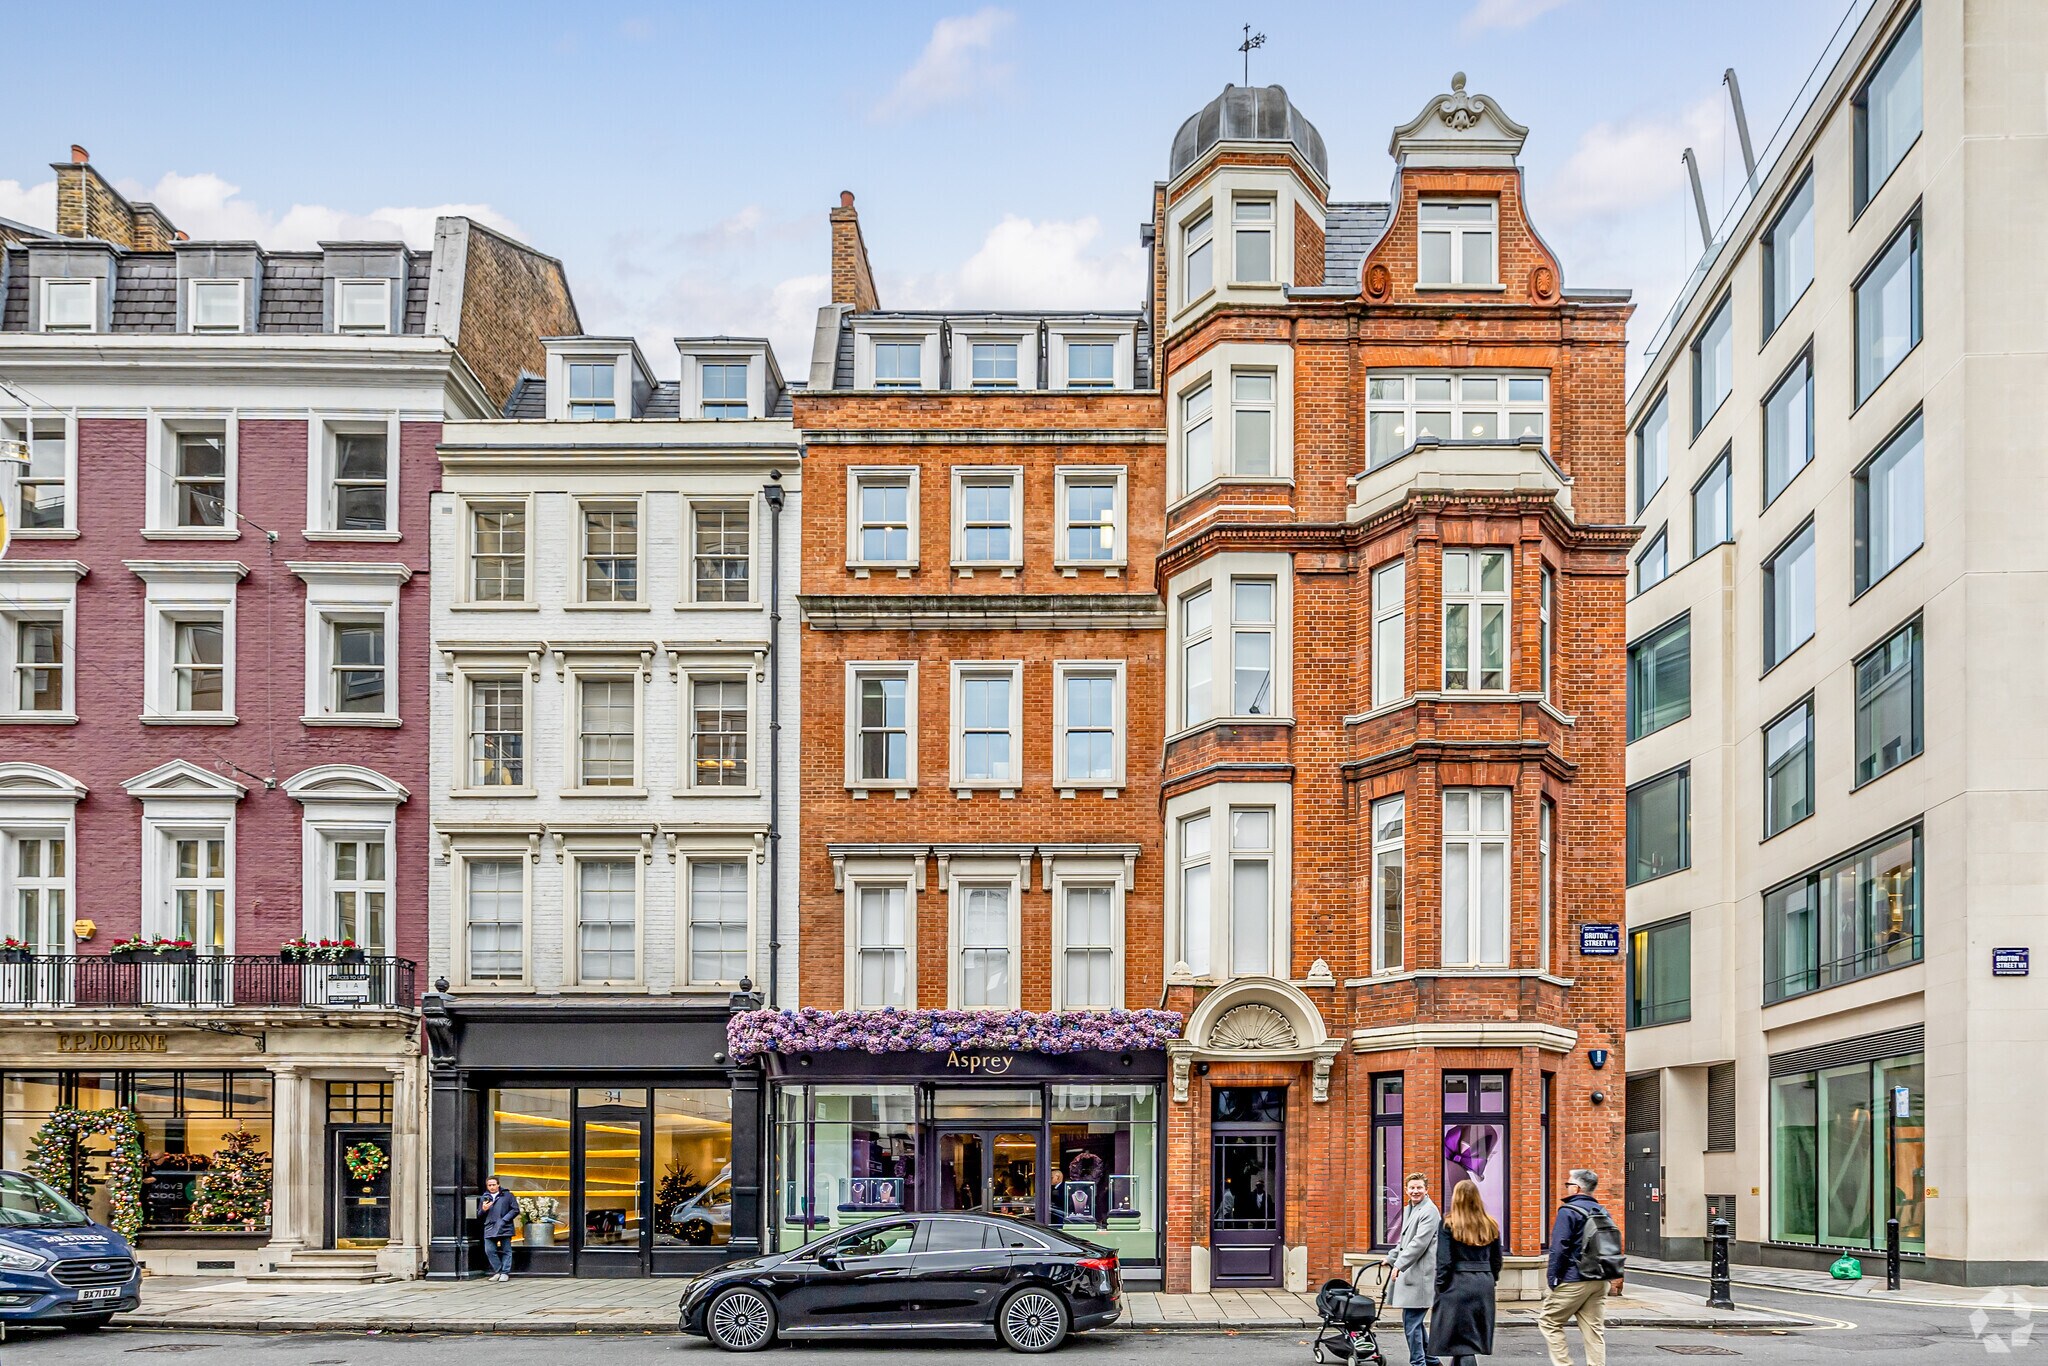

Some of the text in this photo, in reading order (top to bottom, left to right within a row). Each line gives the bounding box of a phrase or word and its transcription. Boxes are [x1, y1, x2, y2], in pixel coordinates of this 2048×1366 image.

[946, 1050, 1014, 1074] Asprey
[604, 1090, 622, 1103] 34
[83, 1288, 118, 1299] BX71 DXZ
